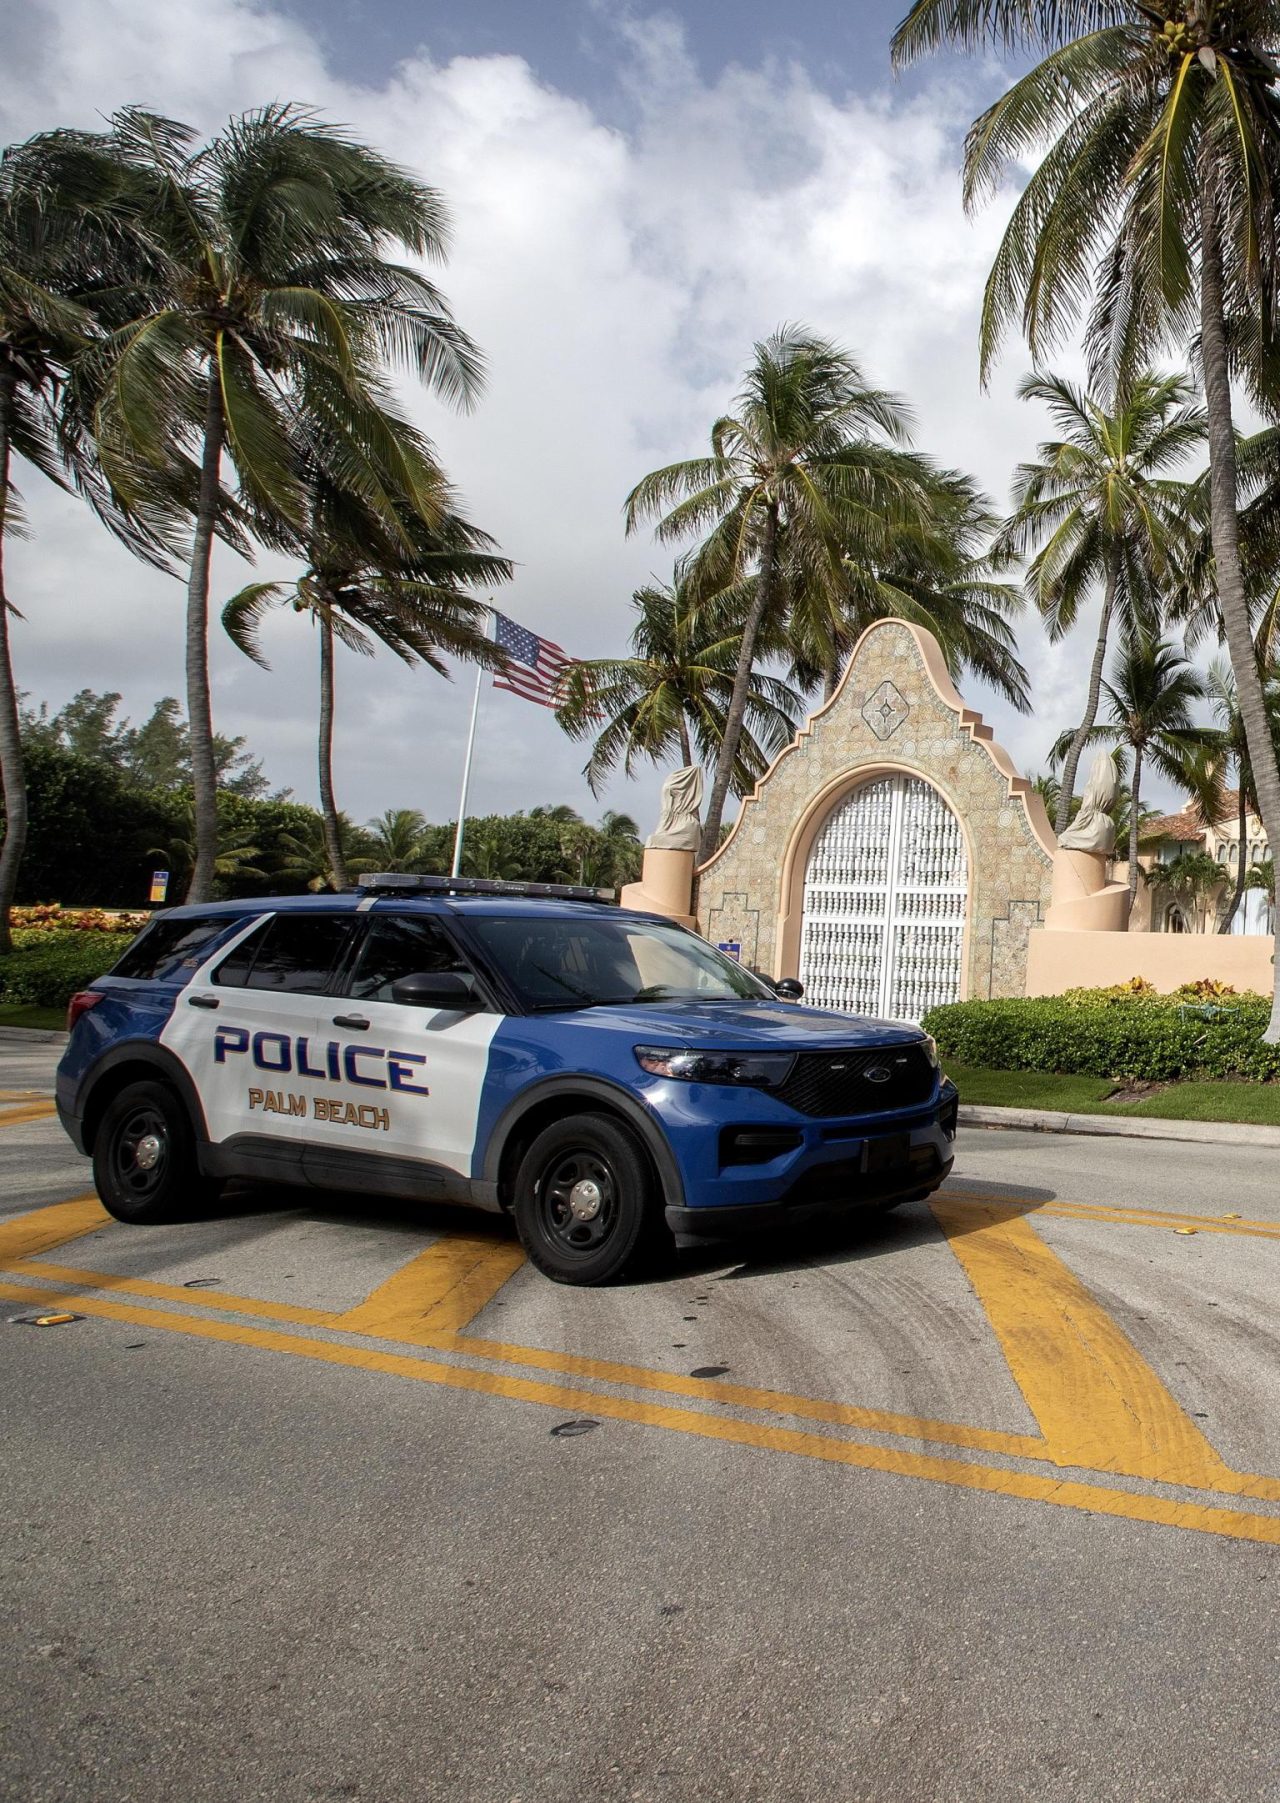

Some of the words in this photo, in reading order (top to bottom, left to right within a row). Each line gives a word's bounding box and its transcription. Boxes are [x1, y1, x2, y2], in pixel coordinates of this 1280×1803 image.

[214, 1025, 430, 1097] POLICE
[248, 1087, 307, 1117] PALM
[313, 1097, 390, 1131] BEACH
